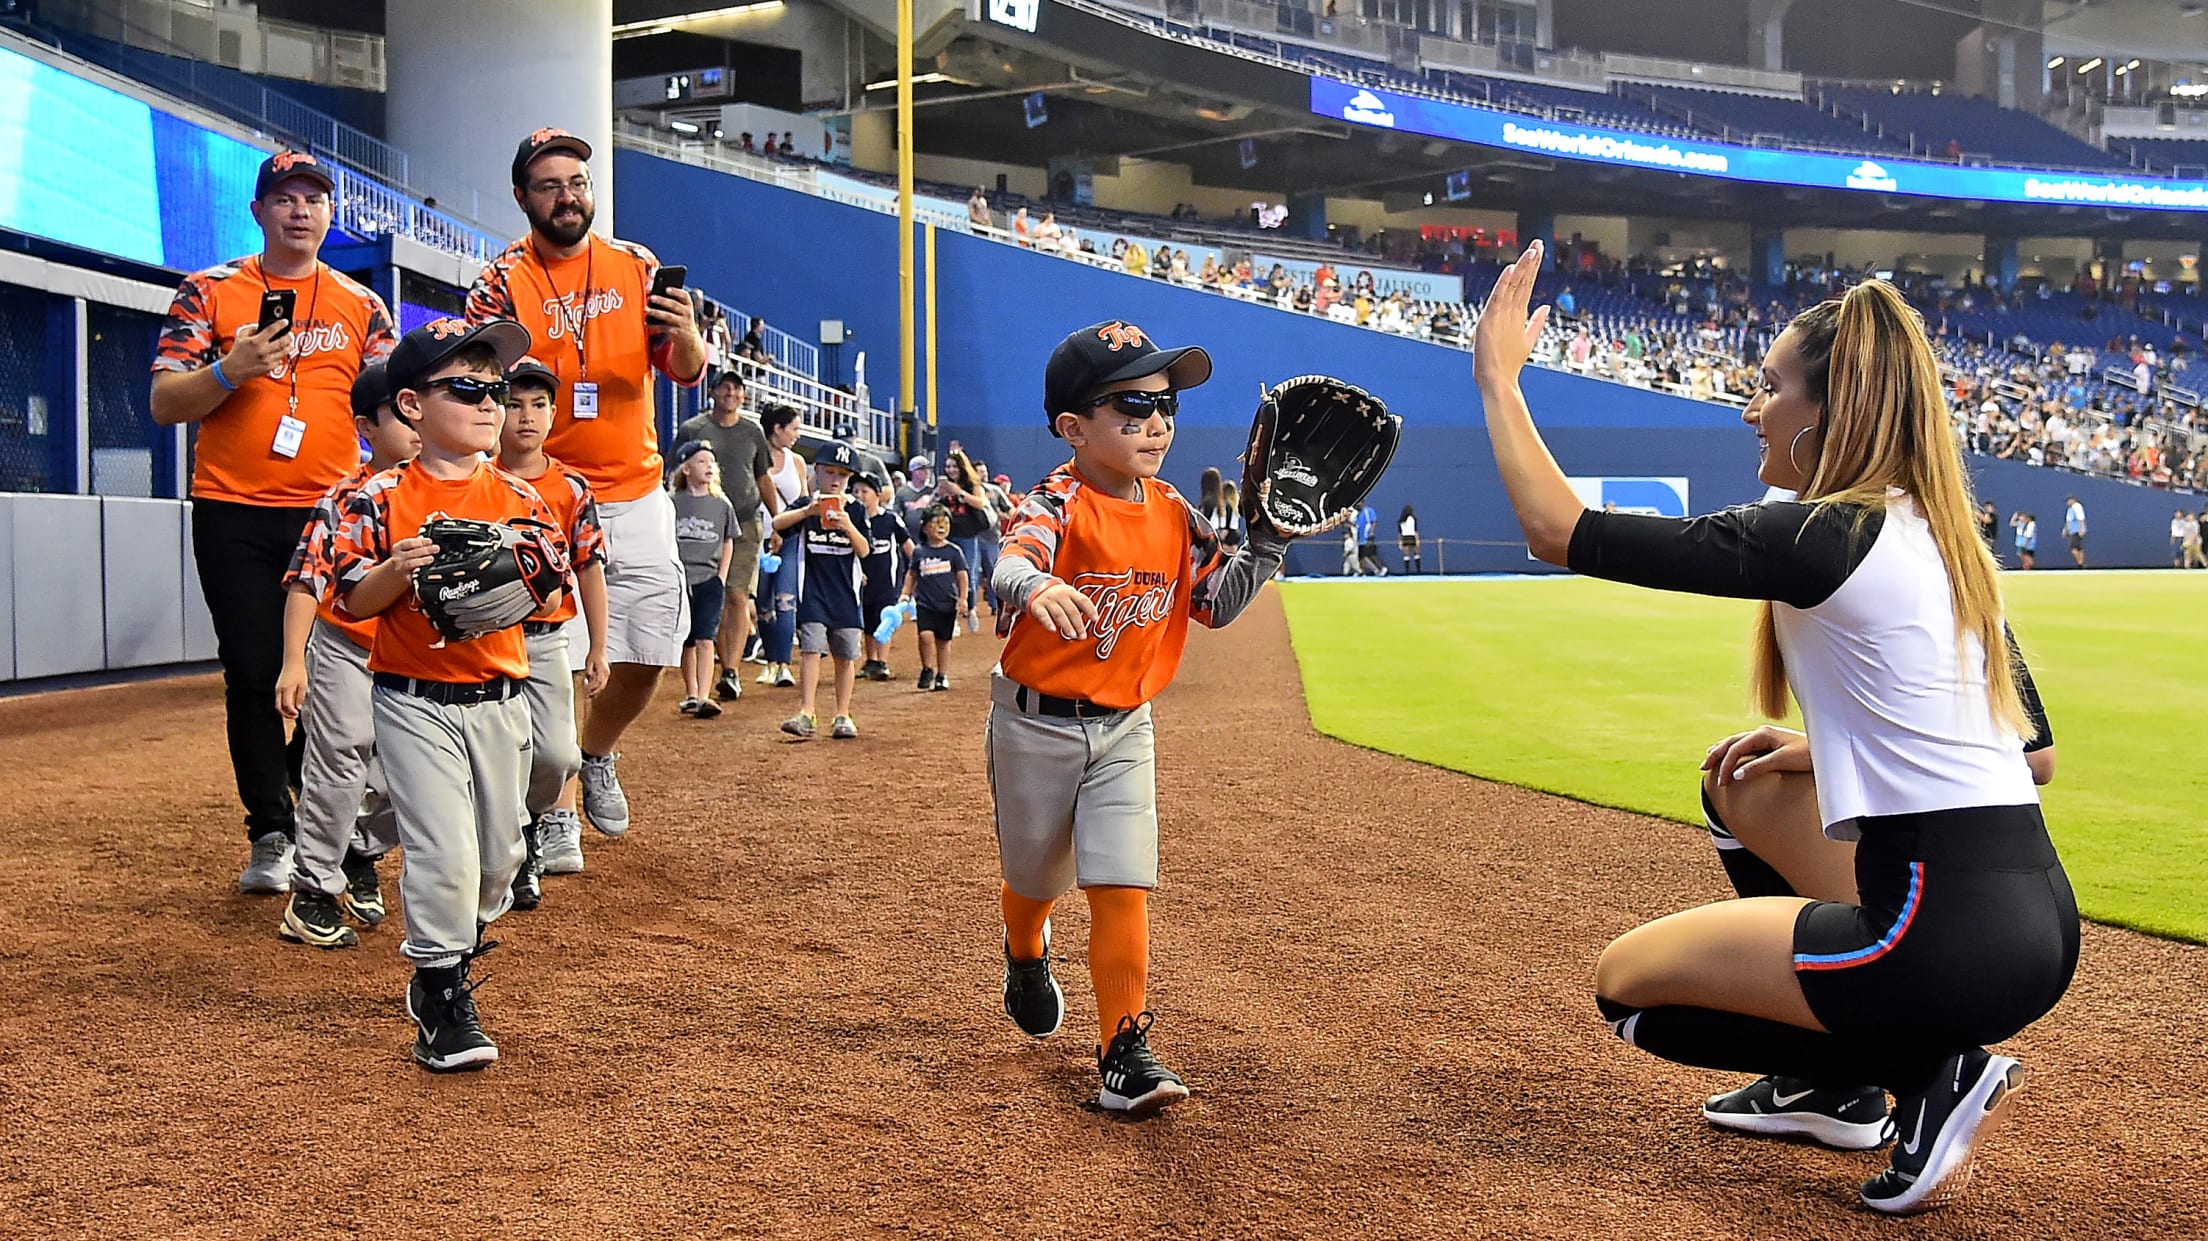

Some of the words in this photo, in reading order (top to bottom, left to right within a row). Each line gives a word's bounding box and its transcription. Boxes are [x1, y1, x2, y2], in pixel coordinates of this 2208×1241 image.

[1503, 122, 1728, 173] SeaWorldOrlando.com
[1377, 277, 1432, 295] JALISCO
[543, 288, 623, 343] Tigers
[439, 579, 480, 601] Rawlings
